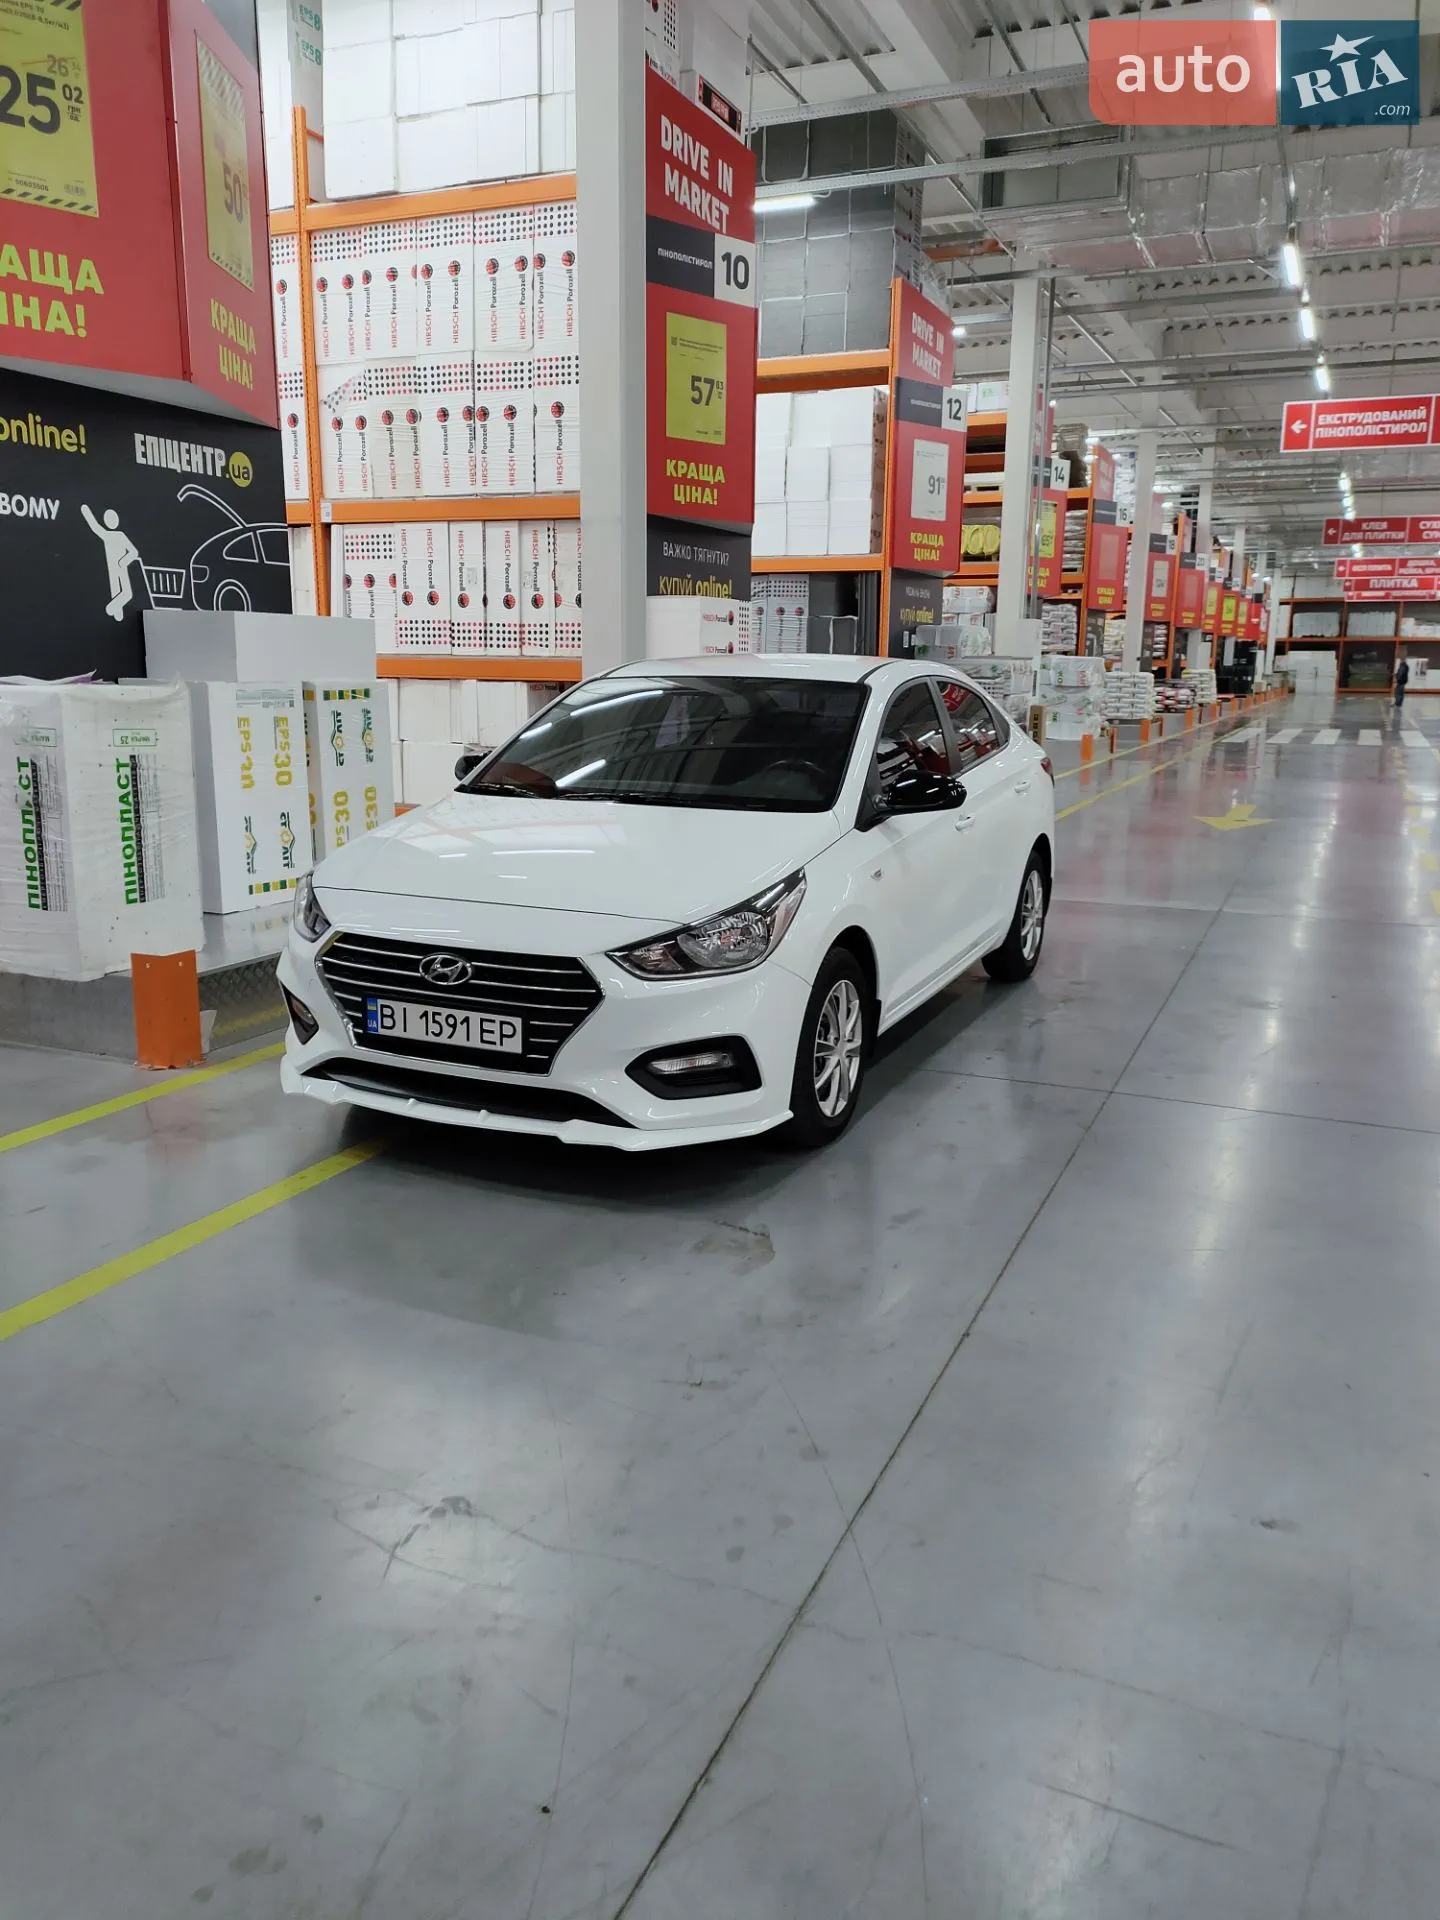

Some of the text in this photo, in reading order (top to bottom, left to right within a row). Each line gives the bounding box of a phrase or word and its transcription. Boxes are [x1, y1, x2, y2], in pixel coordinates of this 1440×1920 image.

[0, 65, 84, 134] 25 02
[660, 114, 733, 198] DRIVE IN
[664, 162, 730, 235] MARKET
[721, 251, 750, 290] 10
[210, 298, 257, 355] КРАЩА
[321, 326, 329, 357] HIRSCH
[346, 323, 355, 355] HIRSCH
[362, 319, 372, 350] HIRSCH
[911, 312, 944, 355] DRIVE IN
[218, 344, 254, 391] ЦІНА!
[912, 342, 942, 380] MARKET
[690, 375, 715, 406] 57
[947, 397, 962, 420] 12
[1318, 406, 1427, 425] ЕКСТРУДОВАНИЙ
[0, 412, 87, 454] online!
[1315, 422, 1428, 438] ПІНОПОЛІСТИРОЛ
[666, 459, 725, 484] КРАЩА
[928, 475, 941, 495] 91
[1054, 466, 1065, 483] 14
[673, 484, 718, 505] ЦІНА!
[663, 541, 730, 566] ВАЖКО ТЯГНУТИ?
[910, 532, 944, 547] КРАЩА
[914, 547, 940, 562] ЦІНА!
[695, 575, 733, 599] online!
[1369, 579, 1418, 588] ПЛИТКА
[274, 716, 292, 786] EPS30
[116, 757, 138, 905] ПІНОПЛАСТ
[367, 1019, 378, 1029] UA
[419, 1009, 470, 1042] 1591
[479, 1017, 517, 1047] EP
